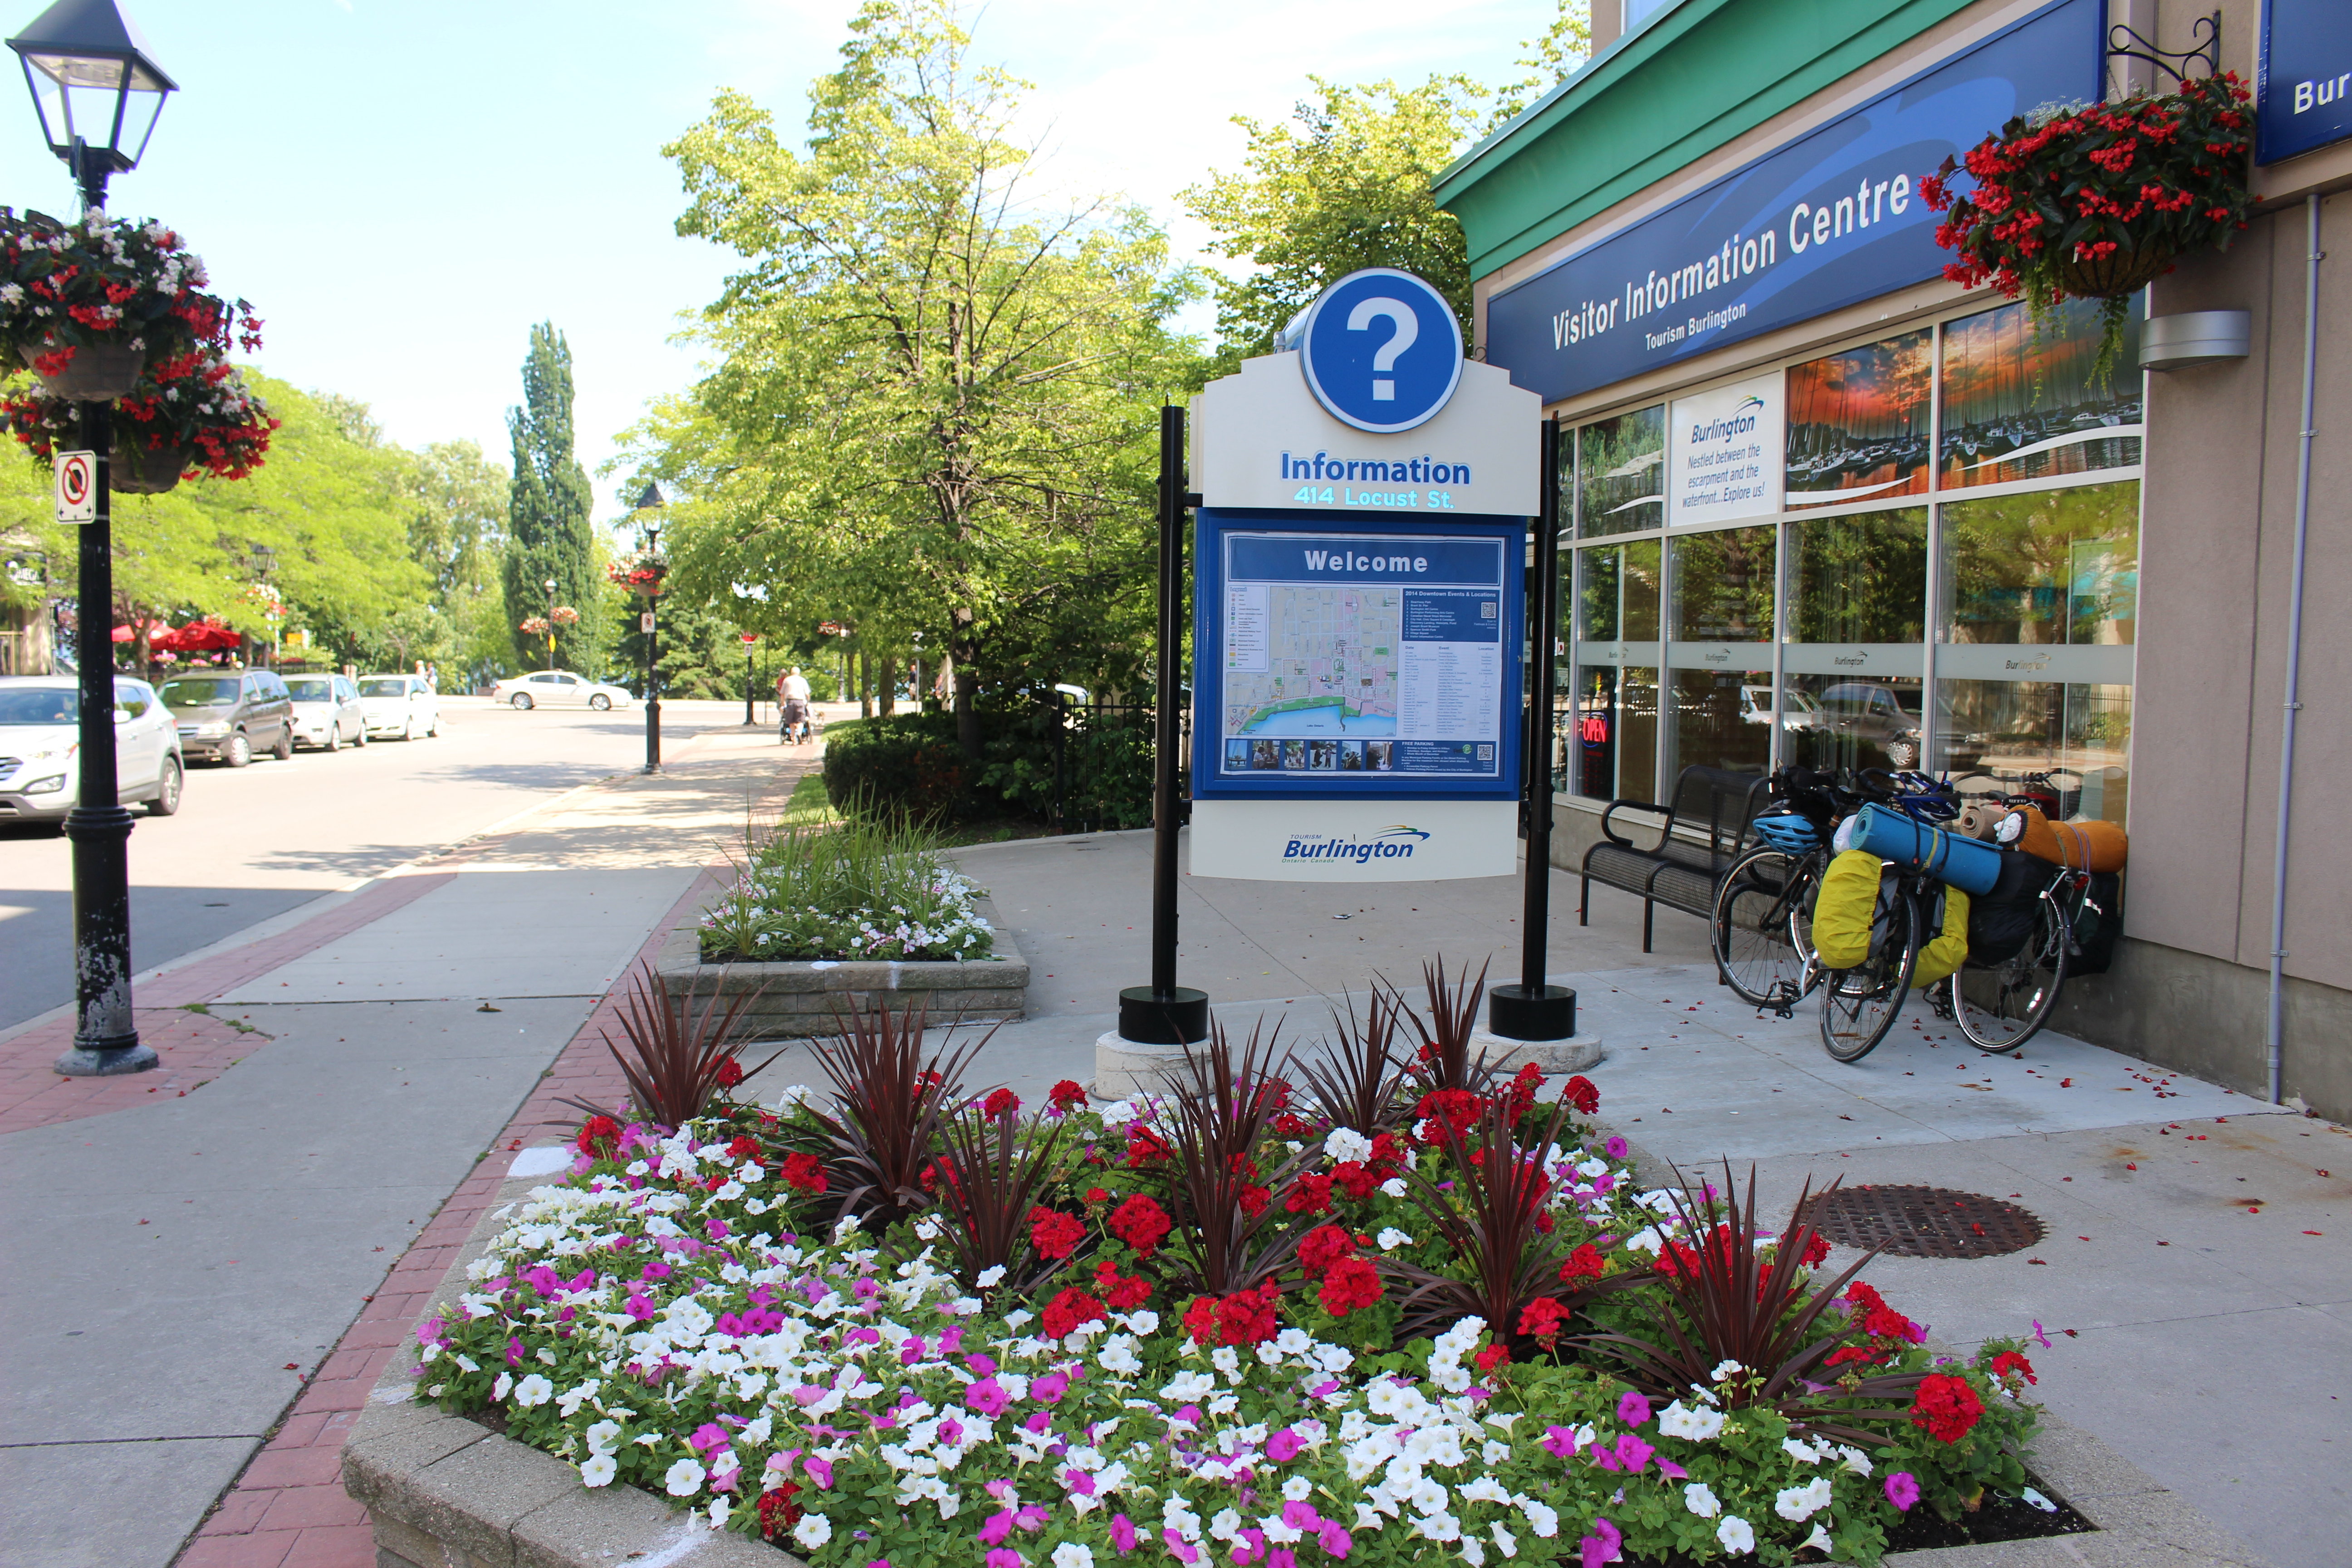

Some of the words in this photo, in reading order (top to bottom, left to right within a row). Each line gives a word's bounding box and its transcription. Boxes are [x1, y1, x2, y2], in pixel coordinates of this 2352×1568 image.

[1553, 297, 1619, 352] Visitor
[1625, 229, 1776, 323] Information
[1789, 173, 1910, 255] Centre
[1645, 325, 1686, 351] Tourism
[1688, 303, 1747, 336] Burlington
[1691, 414, 1755, 444] Burlington
[1282, 453, 1470, 485] Information
[1687, 455, 1714, 470] Nestled
[1715, 449, 1745, 466] between
[1749, 443, 1760, 458] the
[1688, 472, 1728, 490] escarpment
[1730, 468, 1744, 482] and
[1746, 464, 1758, 478] the
[1753, 481, 1765, 498] us!
[1294, 487, 1334, 505] 414
[1346, 488, 1417, 508] Locust
[1427, 490, 1455, 509] St.
[1305, 550, 1428, 573] Welcome
[1834, 657, 1863, 668] Burlington
[2005, 660, 2047, 673] Burlington
[1583, 718, 1606, 743] OPEN
[1284, 839, 1414, 864] Burlington
